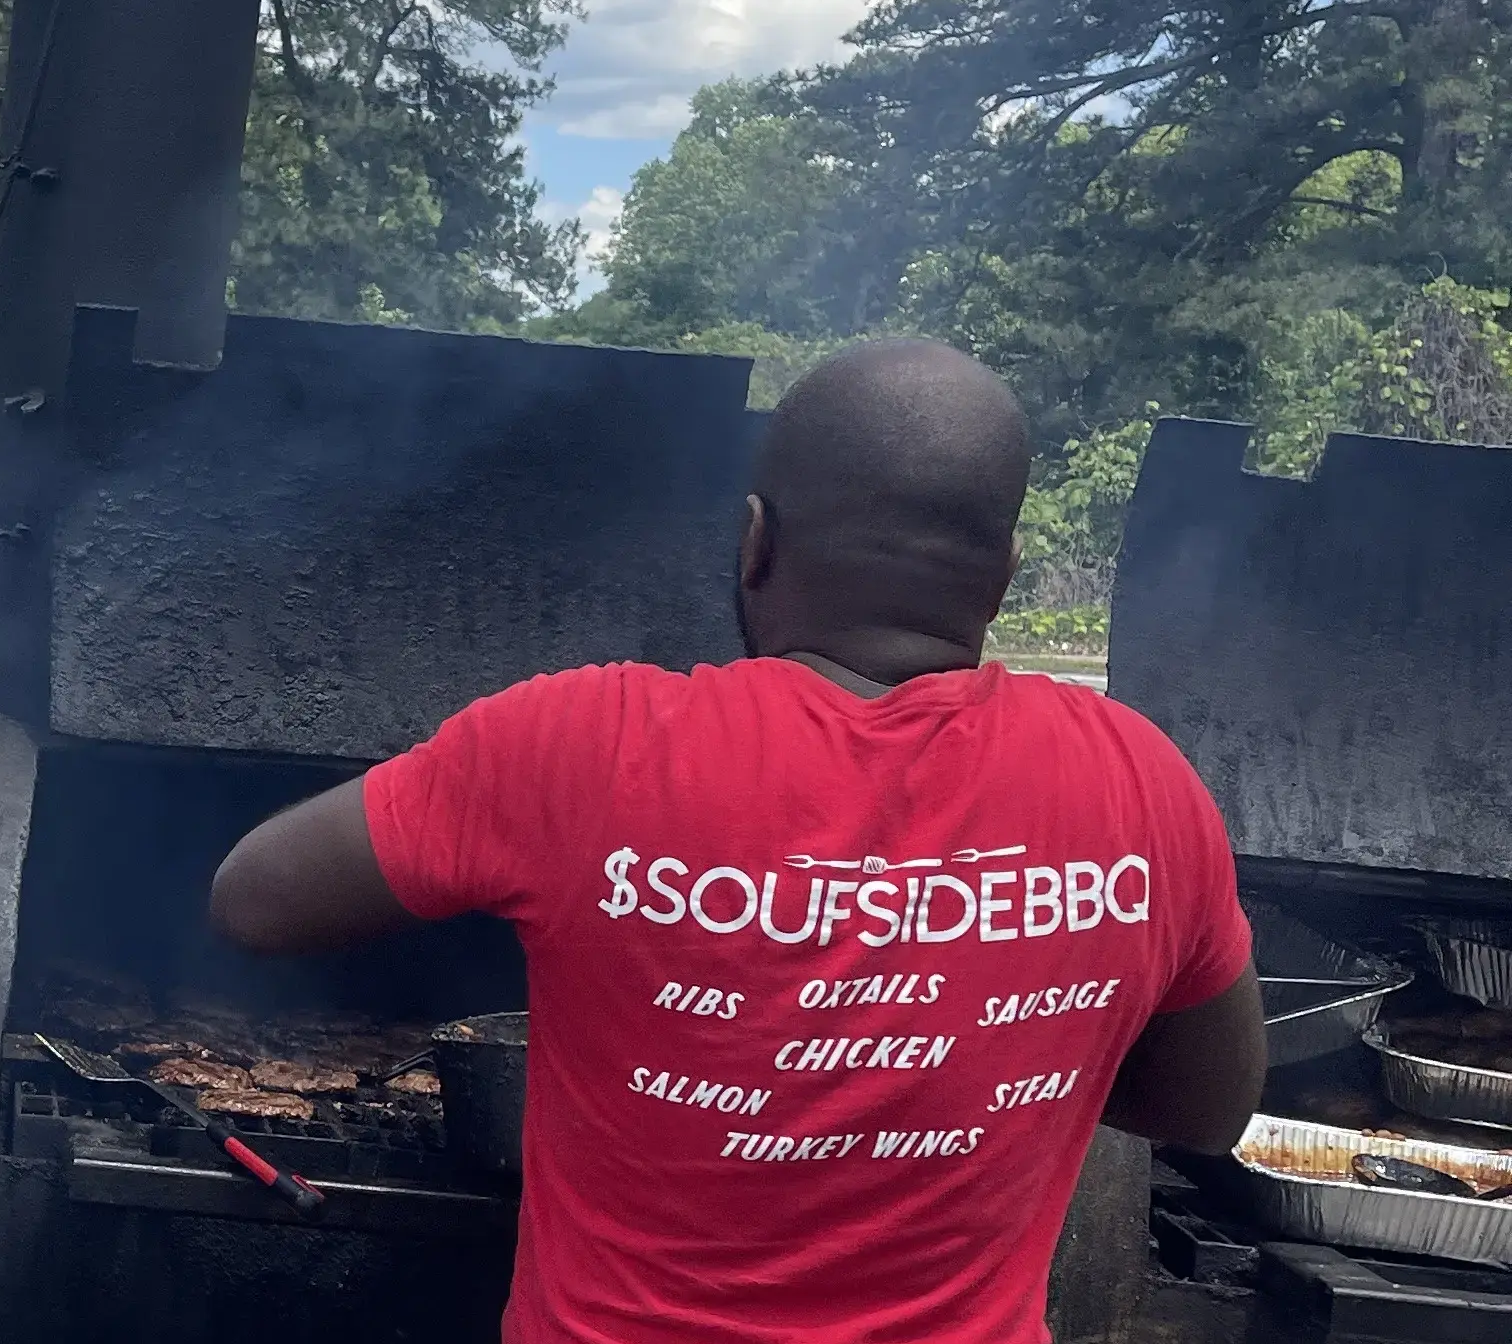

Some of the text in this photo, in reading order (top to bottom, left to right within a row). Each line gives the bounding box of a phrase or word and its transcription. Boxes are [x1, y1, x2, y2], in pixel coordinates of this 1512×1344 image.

[598, 845, 1149, 947] $SOUFSIDEBBQ
[653, 974, 1120, 1026] RIBS OXTAILS SAUSAGE
[775, 1036, 956, 1070] CHICKEN
[628, 1068, 771, 1115] SALMON
[721, 1128, 984, 1161] TURKEY WINGS
